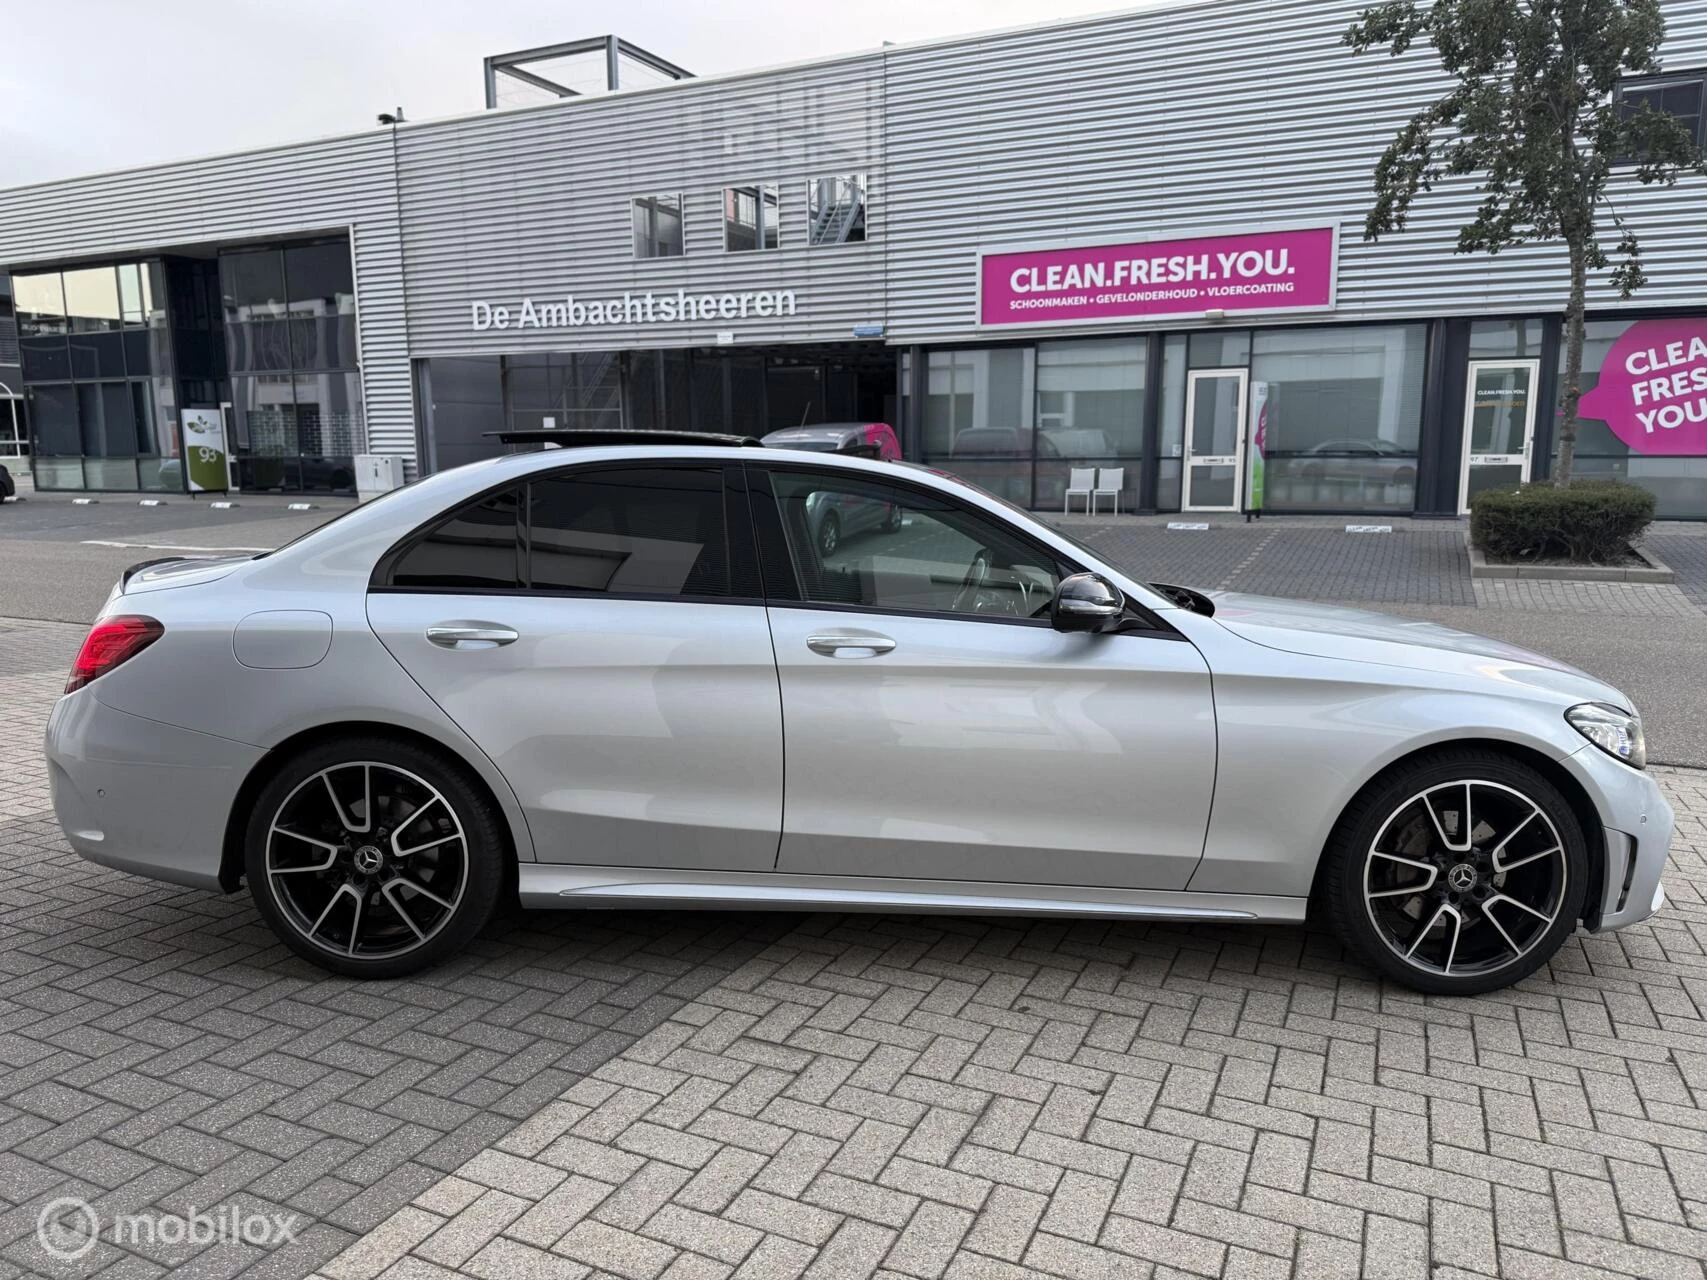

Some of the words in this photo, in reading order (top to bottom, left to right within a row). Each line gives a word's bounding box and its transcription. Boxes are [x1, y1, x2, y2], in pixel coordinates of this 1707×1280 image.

[1010, 248, 1295, 294] CLEAN.FRESH.YOU.
[471, 300, 511, 331] De
[518, 288, 797, 328] Ambachtsheeren
[1010, 295, 1087, 310] SCHOONMAKEN
[1096, 288, 1198, 304] GEVELONDERHOUD
[1207, 282, 1295, 297] VLOERCOATING
[199, 447, 217, 463] 93
